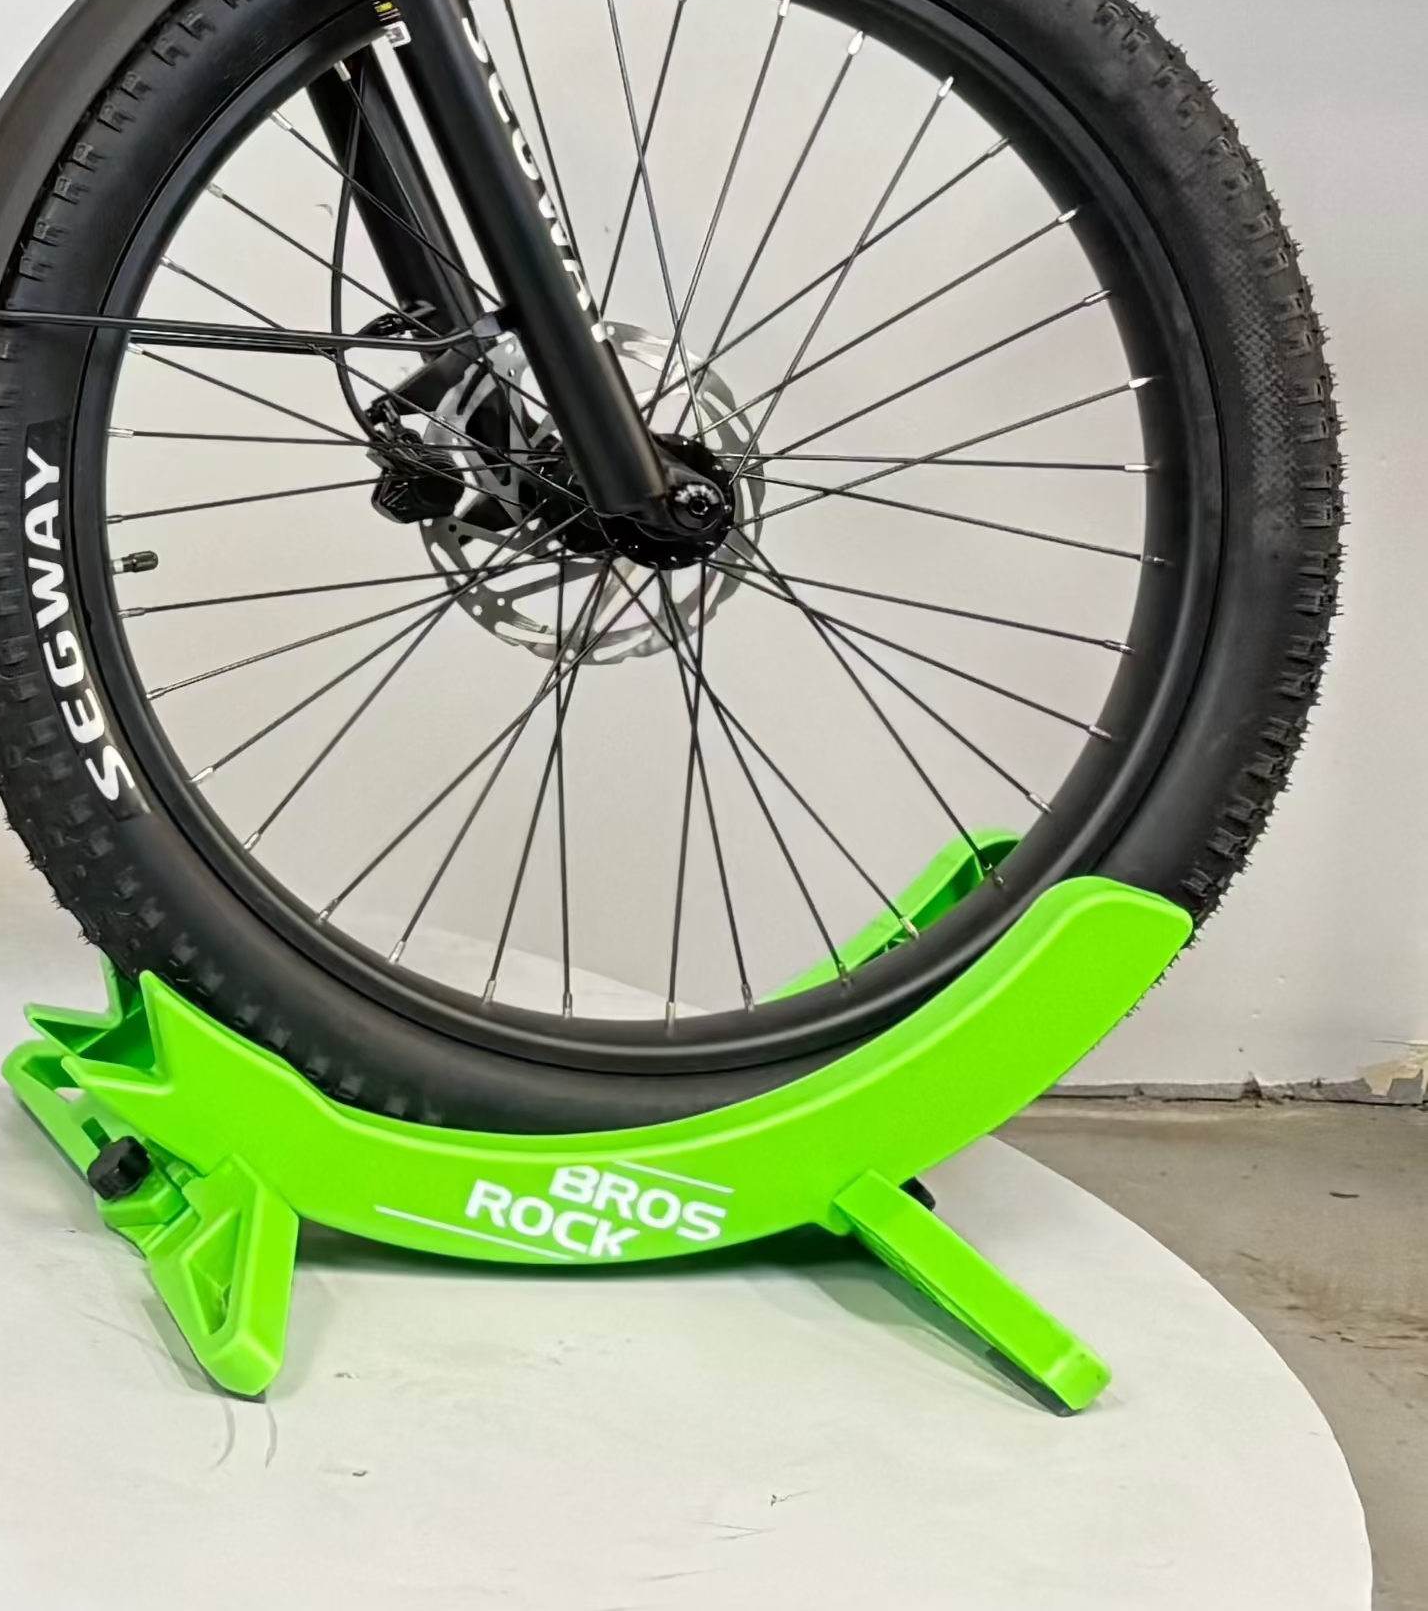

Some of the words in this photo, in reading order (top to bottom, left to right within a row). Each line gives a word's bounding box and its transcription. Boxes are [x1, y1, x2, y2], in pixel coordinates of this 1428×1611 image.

[24, 447, 136, 802] SEGWAY
[464, 1178, 640, 1259] ROCK
[548, 1165, 728, 1242] BROS
